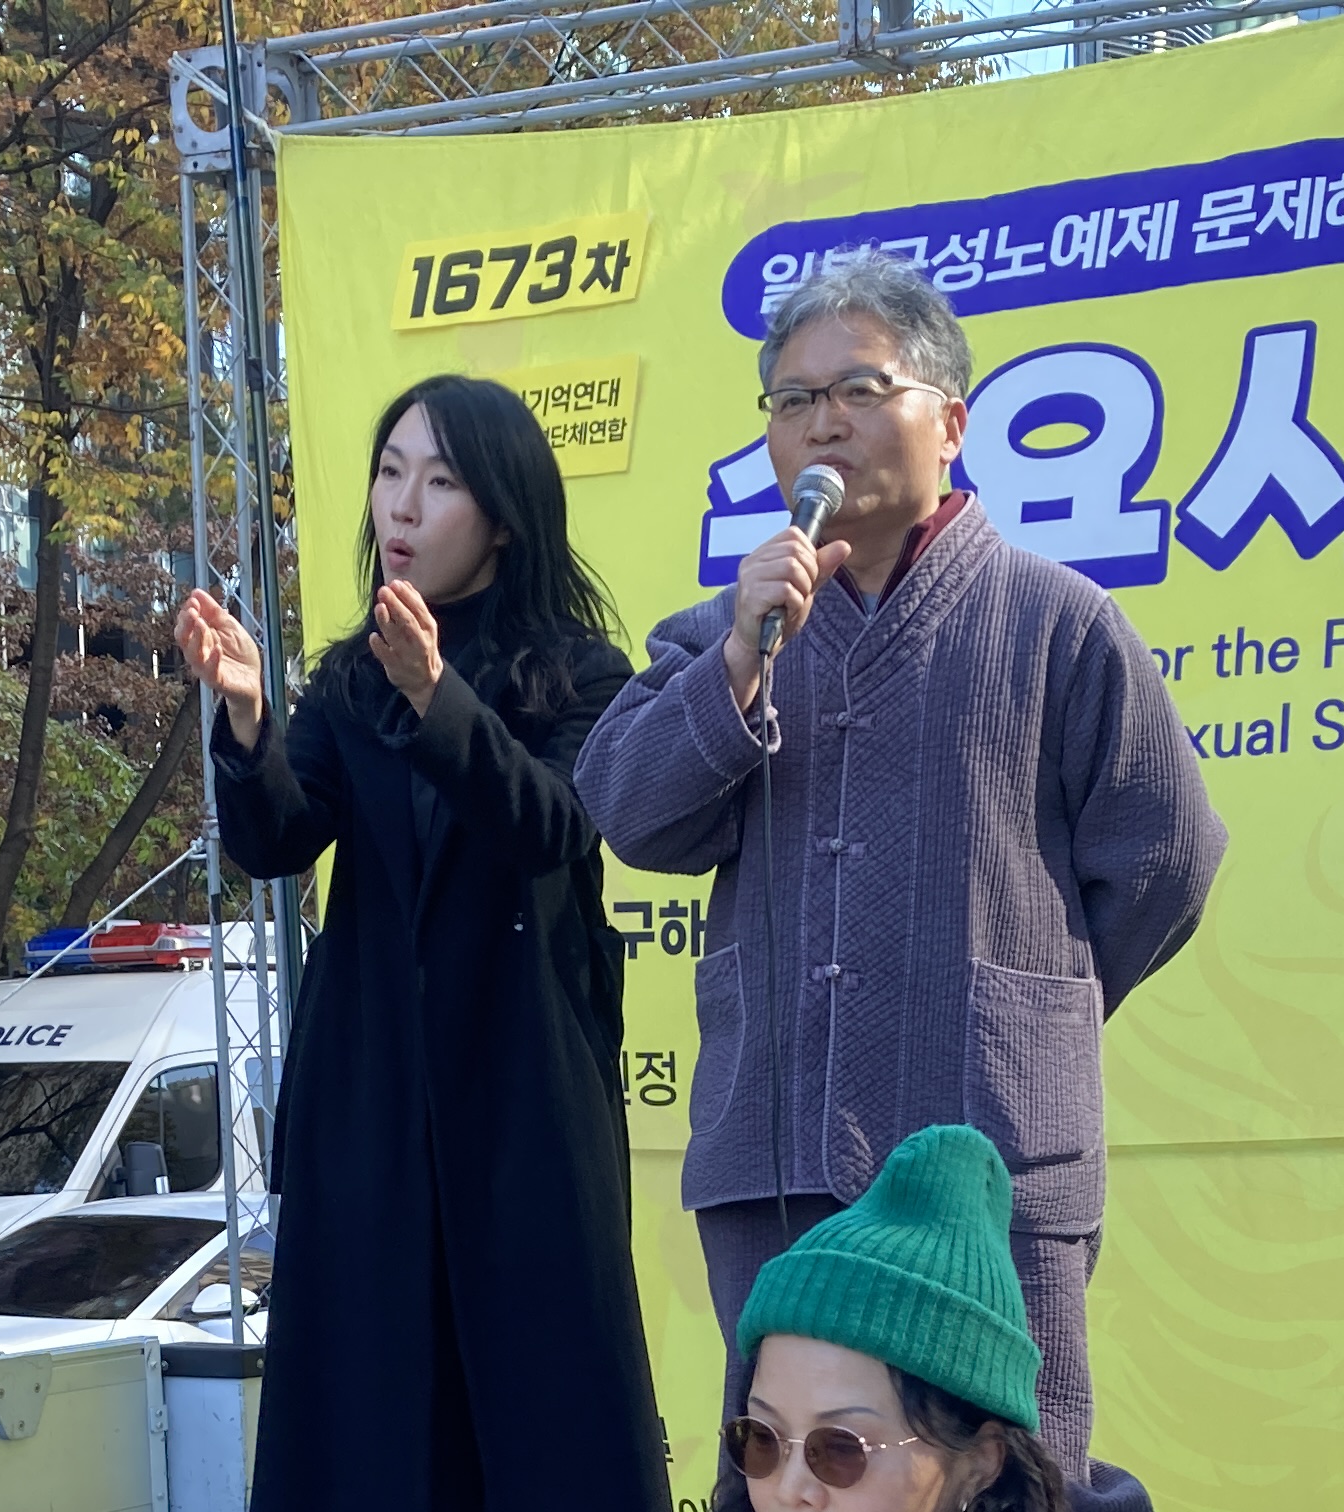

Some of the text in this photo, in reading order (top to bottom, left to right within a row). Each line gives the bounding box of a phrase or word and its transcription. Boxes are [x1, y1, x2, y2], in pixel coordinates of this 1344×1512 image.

[760, 199, 1180, 315] 일성노예제
[520, 377, 622, 418] 기억연대
[545, 417, 628, 450] 단체연합
[1212, 626, 1301, 678] the
[1185, 702, 1291, 760] xual
